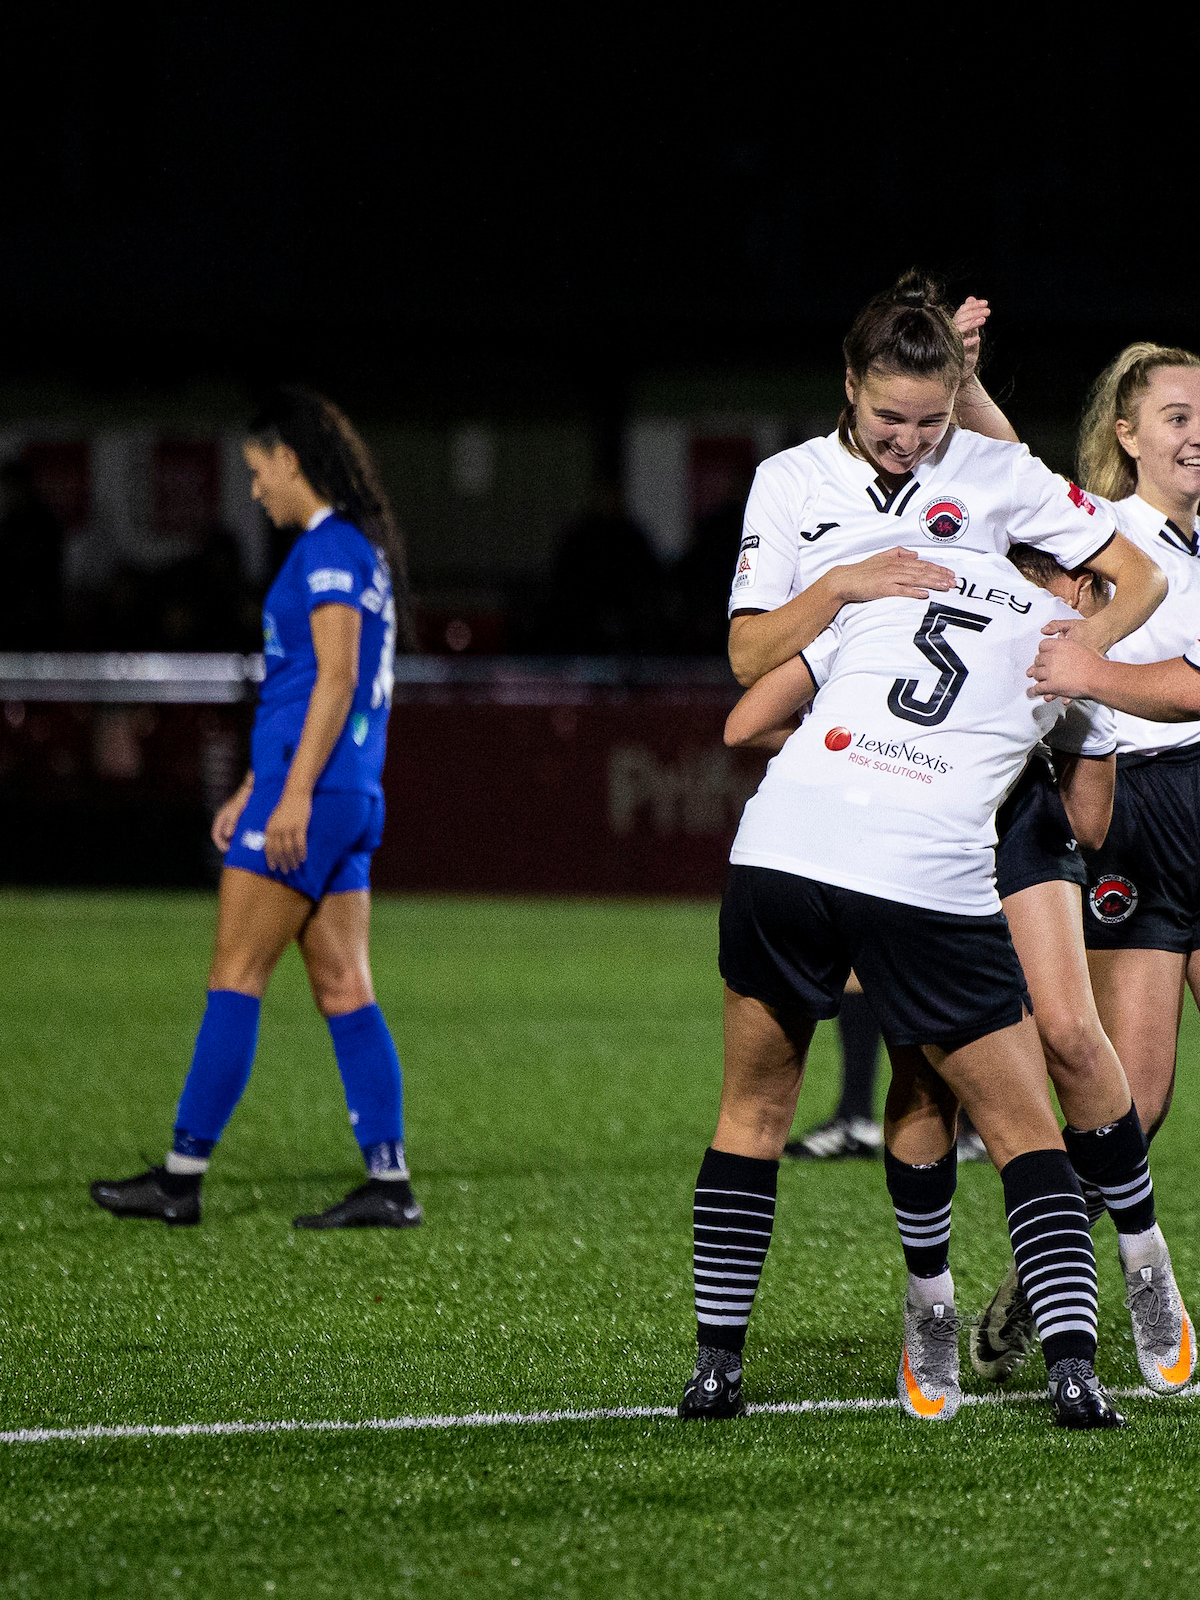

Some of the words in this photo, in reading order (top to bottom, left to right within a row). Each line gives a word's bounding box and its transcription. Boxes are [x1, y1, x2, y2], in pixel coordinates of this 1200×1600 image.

[887, 601, 993, 726] 5
[848, 752, 872, 767] RISK
[872, 760, 934, 784] SOLUTIONS
[856, 733, 948, 774] LexisNexis
